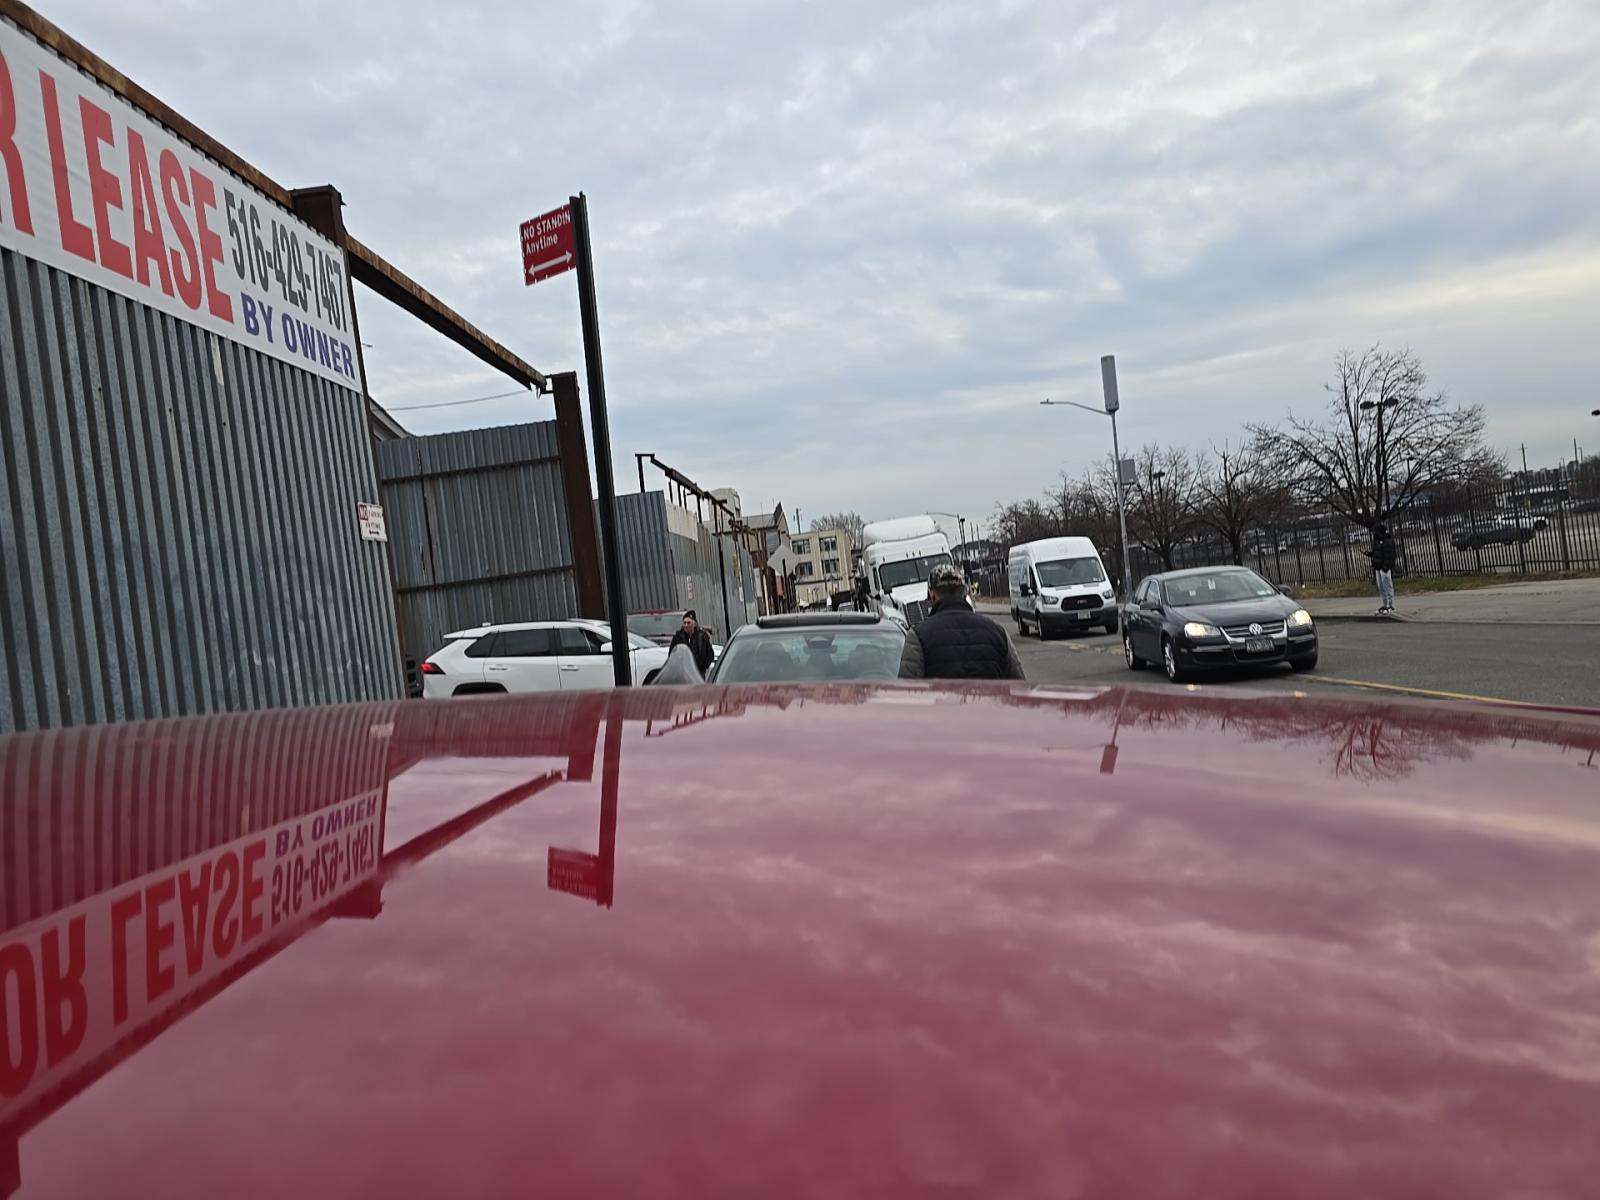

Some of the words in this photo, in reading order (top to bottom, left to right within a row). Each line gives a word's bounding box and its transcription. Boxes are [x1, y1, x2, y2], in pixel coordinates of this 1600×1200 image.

[39, 69, 234, 324] LEASE
[523, 225, 535, 241] NO
[536, 210, 571, 236] STANDIN
[224, 187, 348, 333] 516-429-7467
[526, 233, 558, 256] Anytime
[241, 292, 274, 344] BY
[282, 312, 356, 380] OWNER
